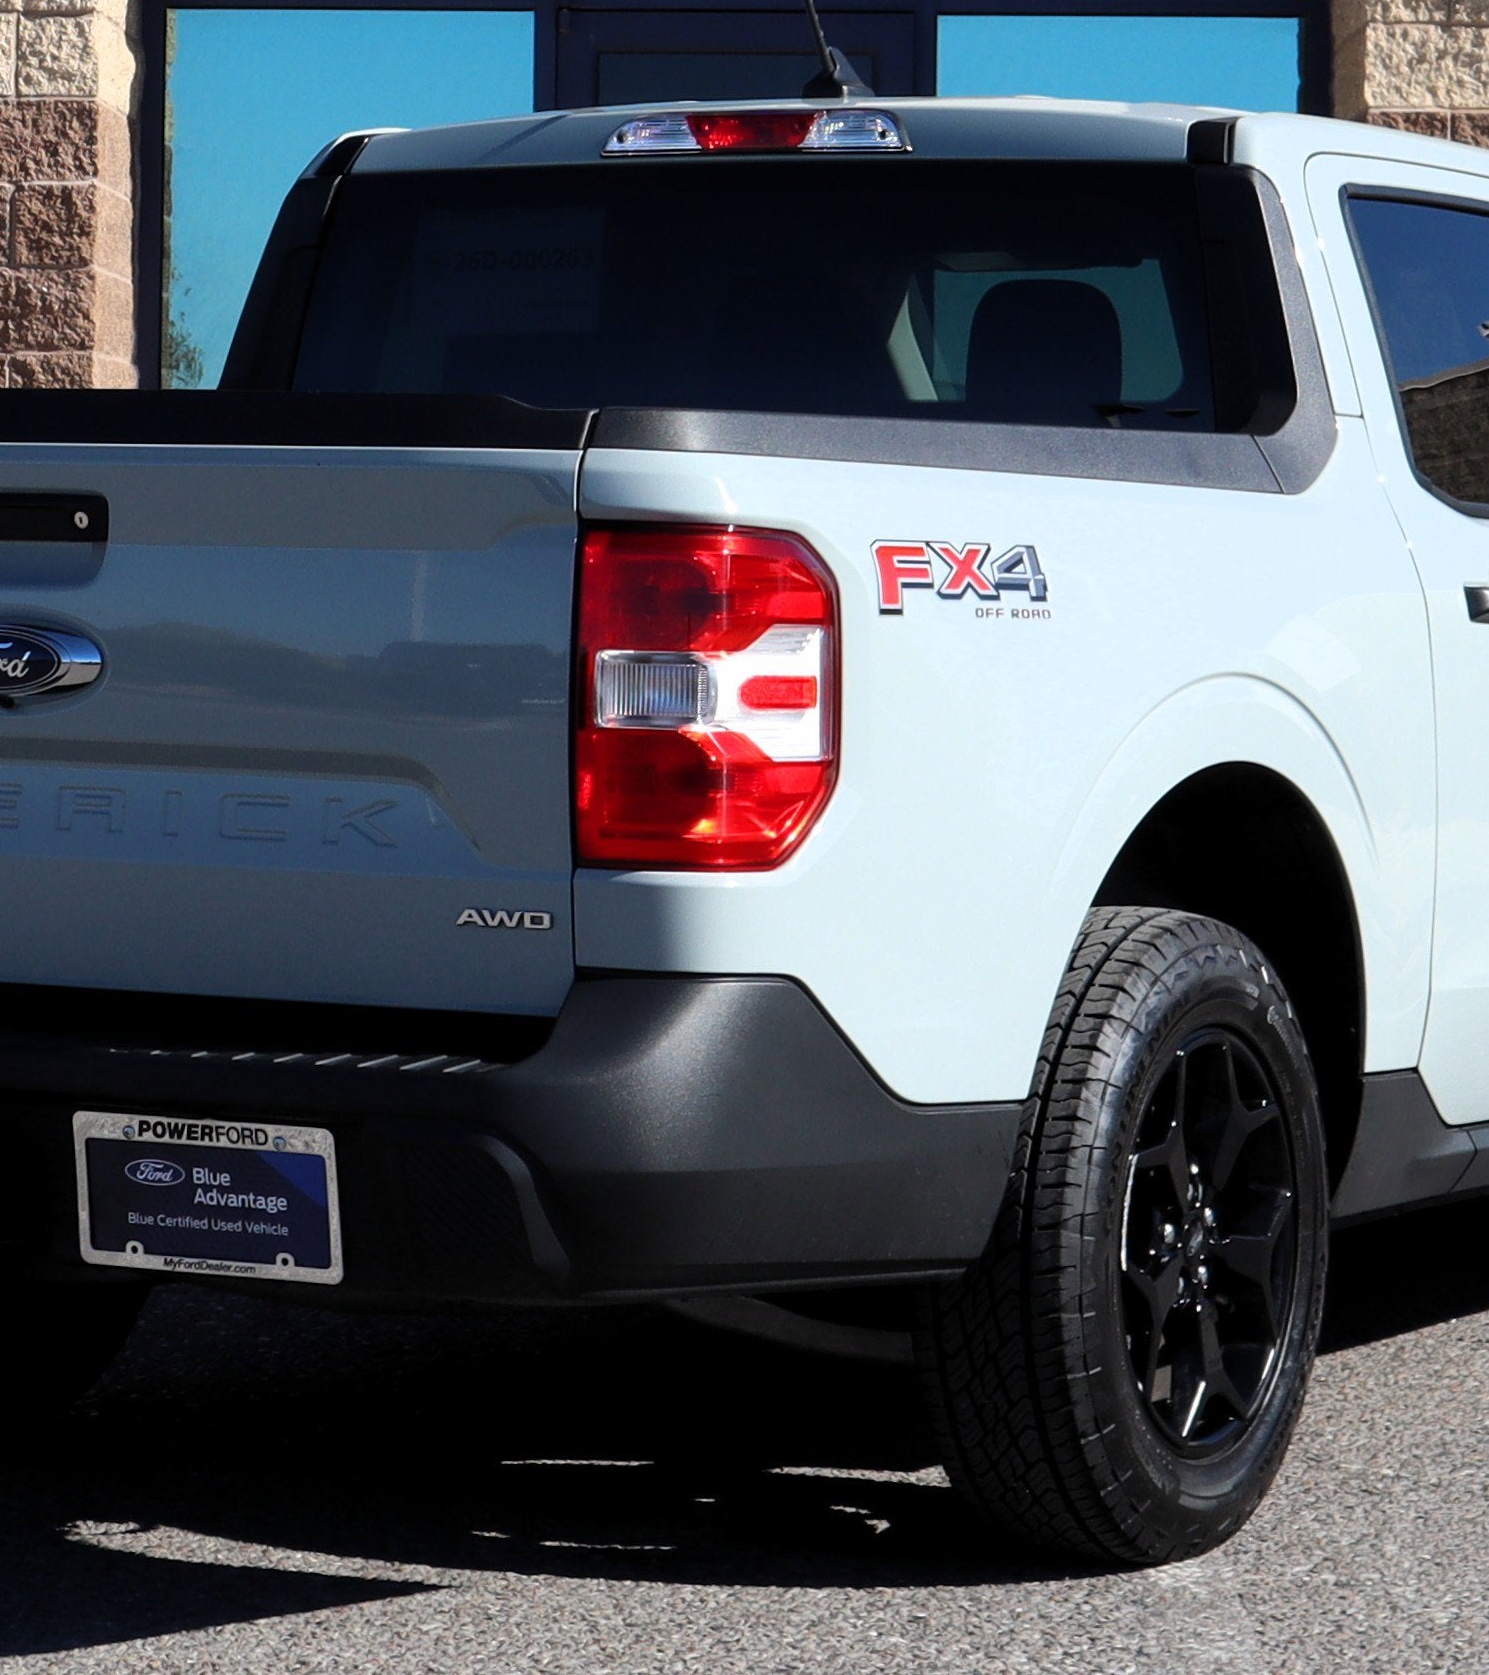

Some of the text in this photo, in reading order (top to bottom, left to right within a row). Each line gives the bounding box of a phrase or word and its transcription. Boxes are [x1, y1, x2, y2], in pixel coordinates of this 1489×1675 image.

[870, 539, 1048, 615] FX4
[975, 607, 1052, 620] OFF ROAD
[454, 907, 552, 931] AWD
[137, 1120, 268, 1146] POWERFORD
[136, 1160, 175, 1183] Ford
[192, 1168, 231, 1186] Blue
[194, 1188, 288, 1213] Advantage
[127, 1211, 289, 1237] Blue Certified Used Vehicle
[163, 1256, 256, 1274] MyFordDealer.com
